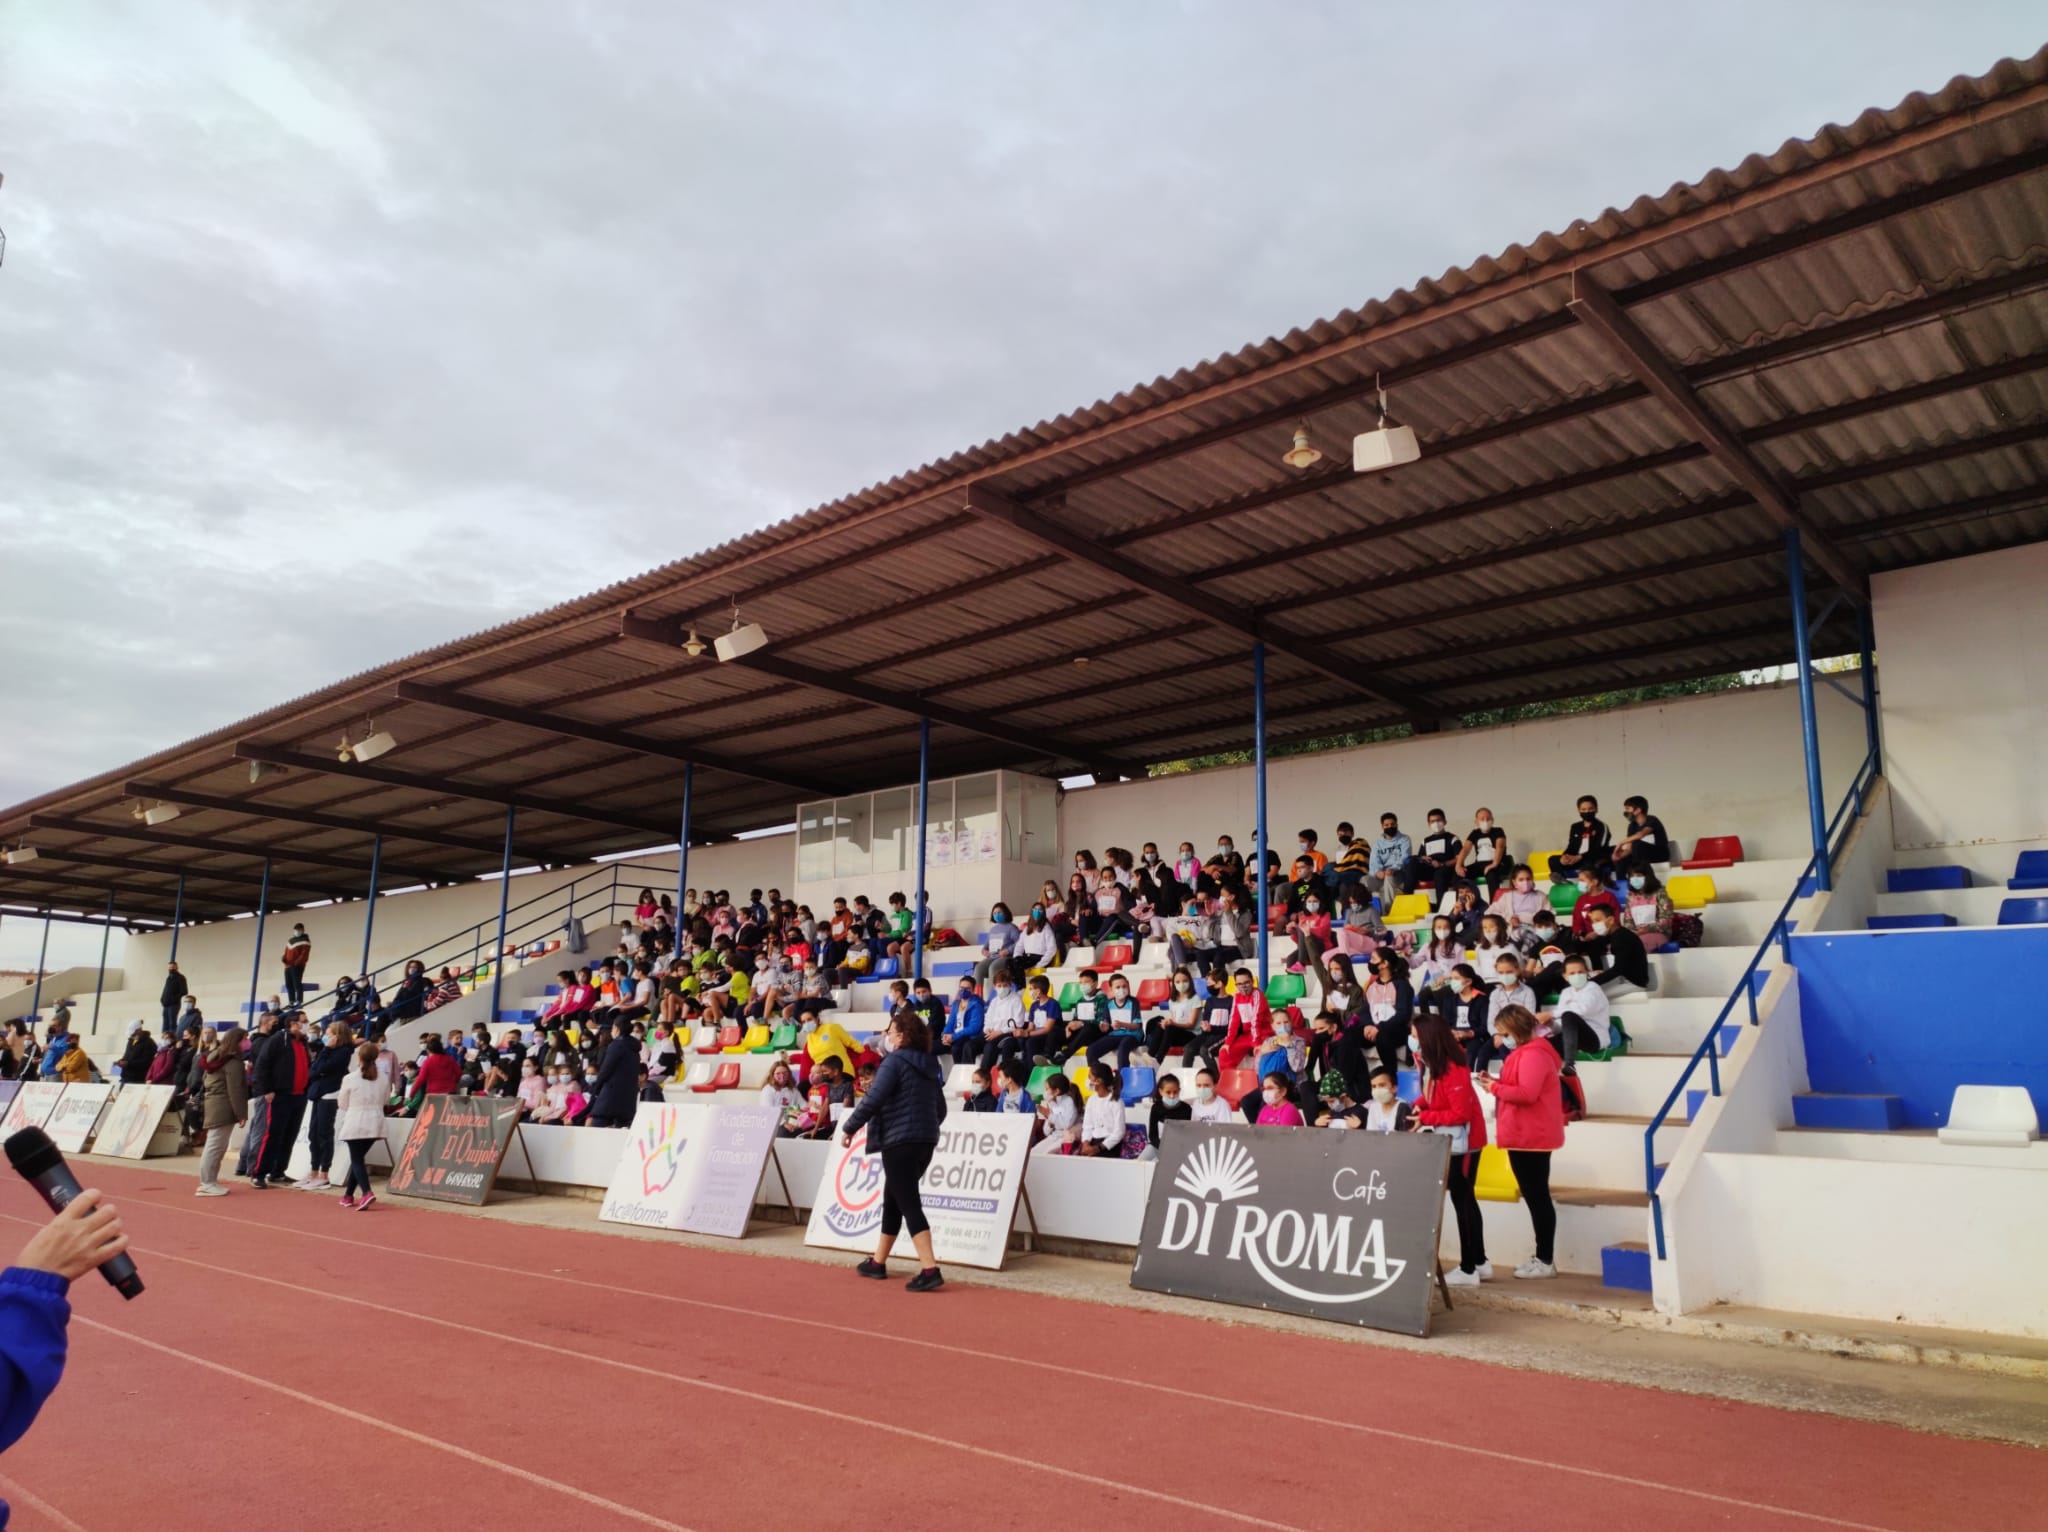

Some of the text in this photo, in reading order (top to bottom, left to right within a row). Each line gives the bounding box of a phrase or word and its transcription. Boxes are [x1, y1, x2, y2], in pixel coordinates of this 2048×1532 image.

[941, 1198, 949, 1208] A
[1332, 1167, 1387, 1206] Café
[1157, 1197, 1408, 1304] DI ROMA
